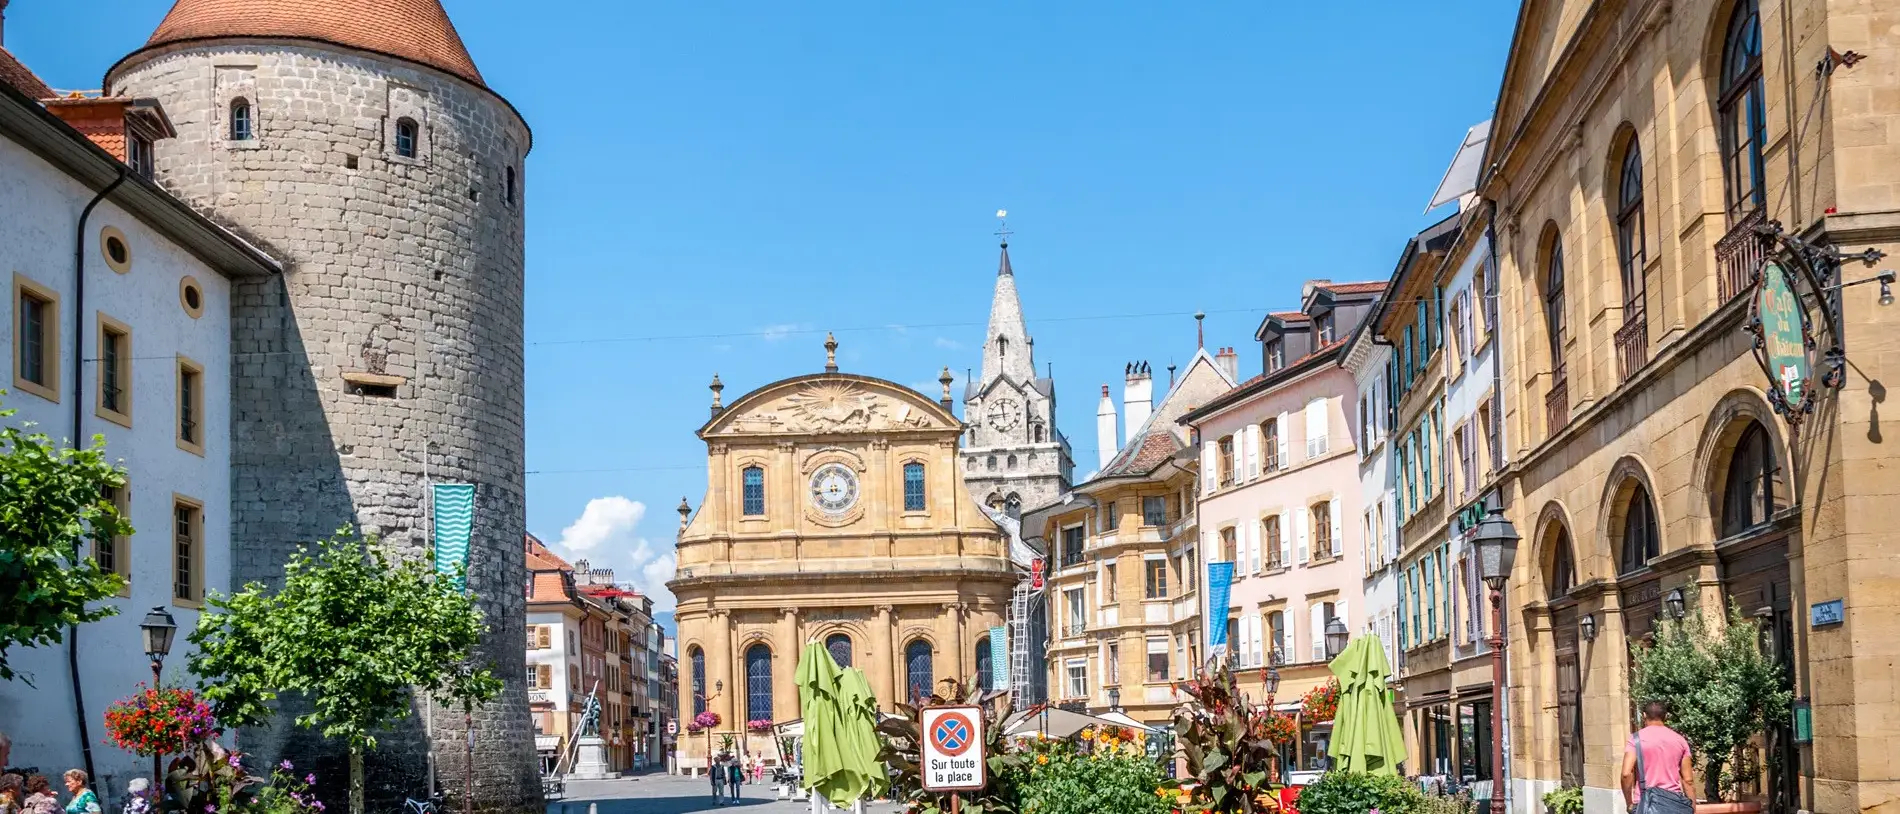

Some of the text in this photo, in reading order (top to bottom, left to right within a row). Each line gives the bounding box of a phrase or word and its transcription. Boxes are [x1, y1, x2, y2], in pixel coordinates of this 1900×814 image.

[1777, 313, 1790, 332] du
[931, 758, 975, 770] Sur toute
[935, 771, 973, 784] la place
